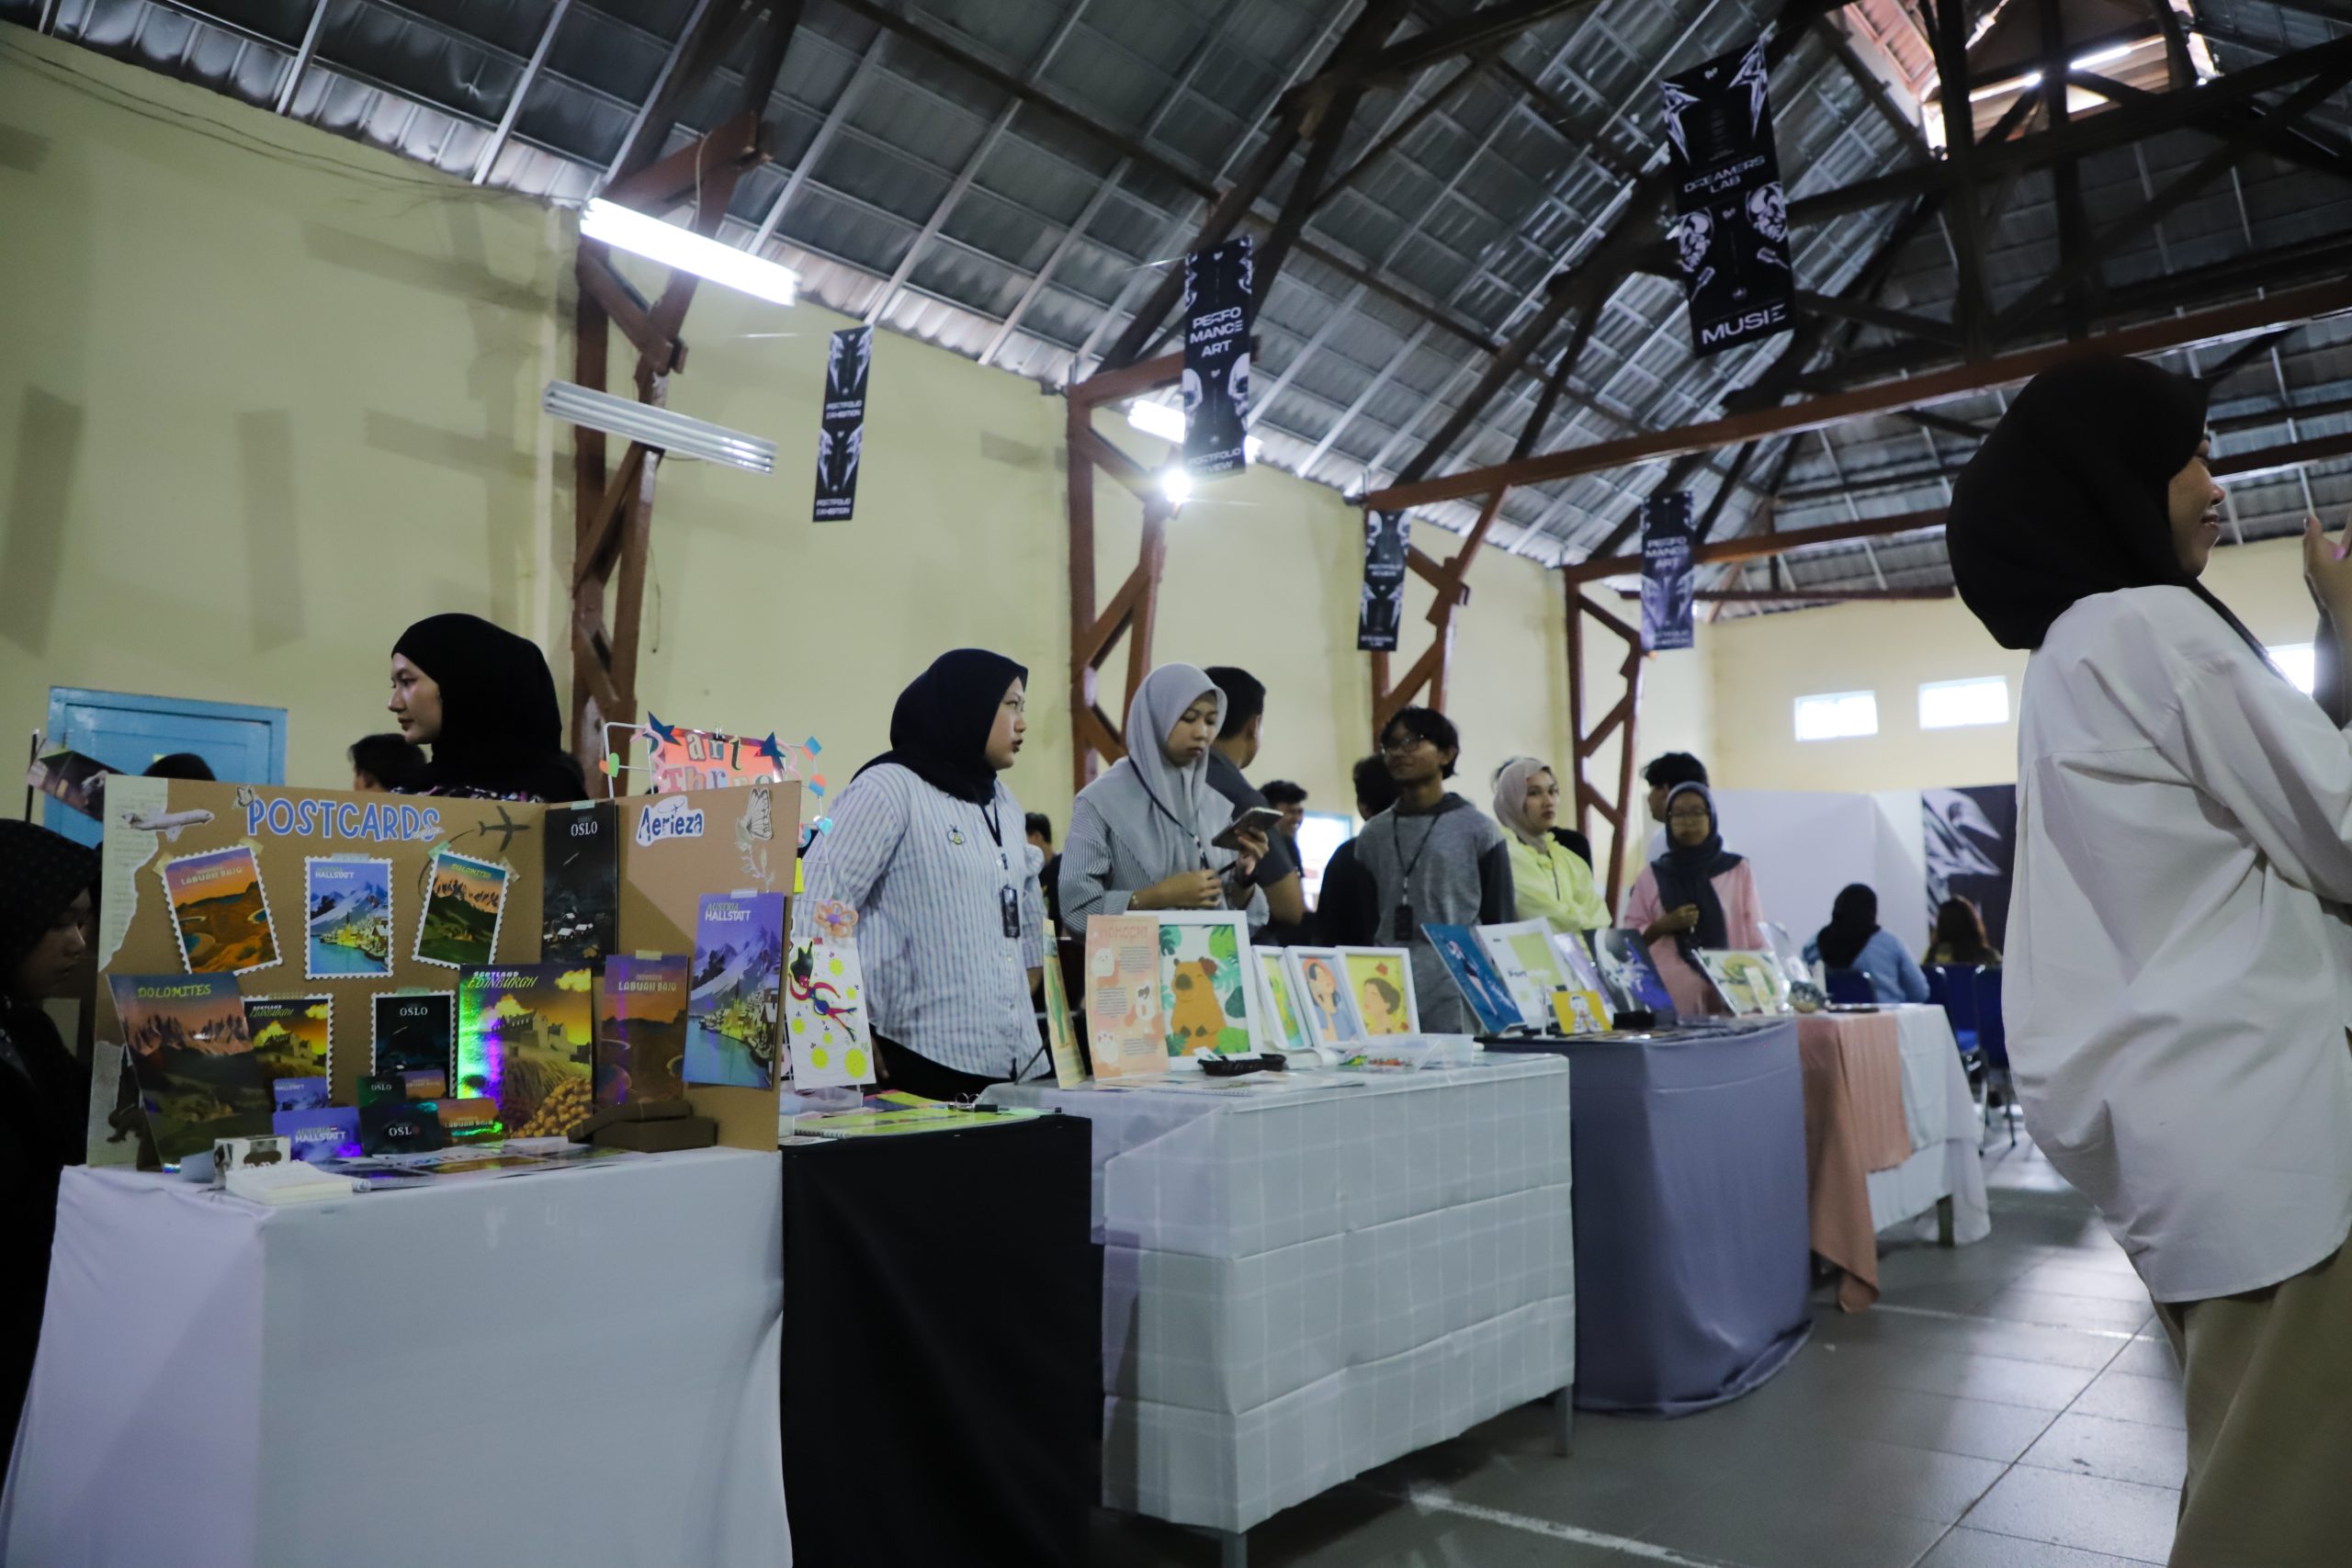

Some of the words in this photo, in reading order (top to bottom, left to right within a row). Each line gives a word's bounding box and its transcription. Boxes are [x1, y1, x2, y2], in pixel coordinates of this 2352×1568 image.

[1710, 175, 1741, 193] LAB
[1190, 320, 1243, 344] MANCE
[1202, 339, 1232, 358] ART
[686, 734, 741, 771] art
[246, 796, 440, 842] POSTCARDS
[638, 807, 704, 842] Aerieza
[571, 821, 598, 837] OSLO
[705, 909, 752, 921] HALLSTATT
[467, 976, 539, 989] EDINBURGH
[137, 984, 211, 998] DOLOMITES
[399, 1006, 428, 1017] OSLO
[370, 1083, 392, 1091] OSLO
[295, 1131, 346, 1144] HALLSTATT
